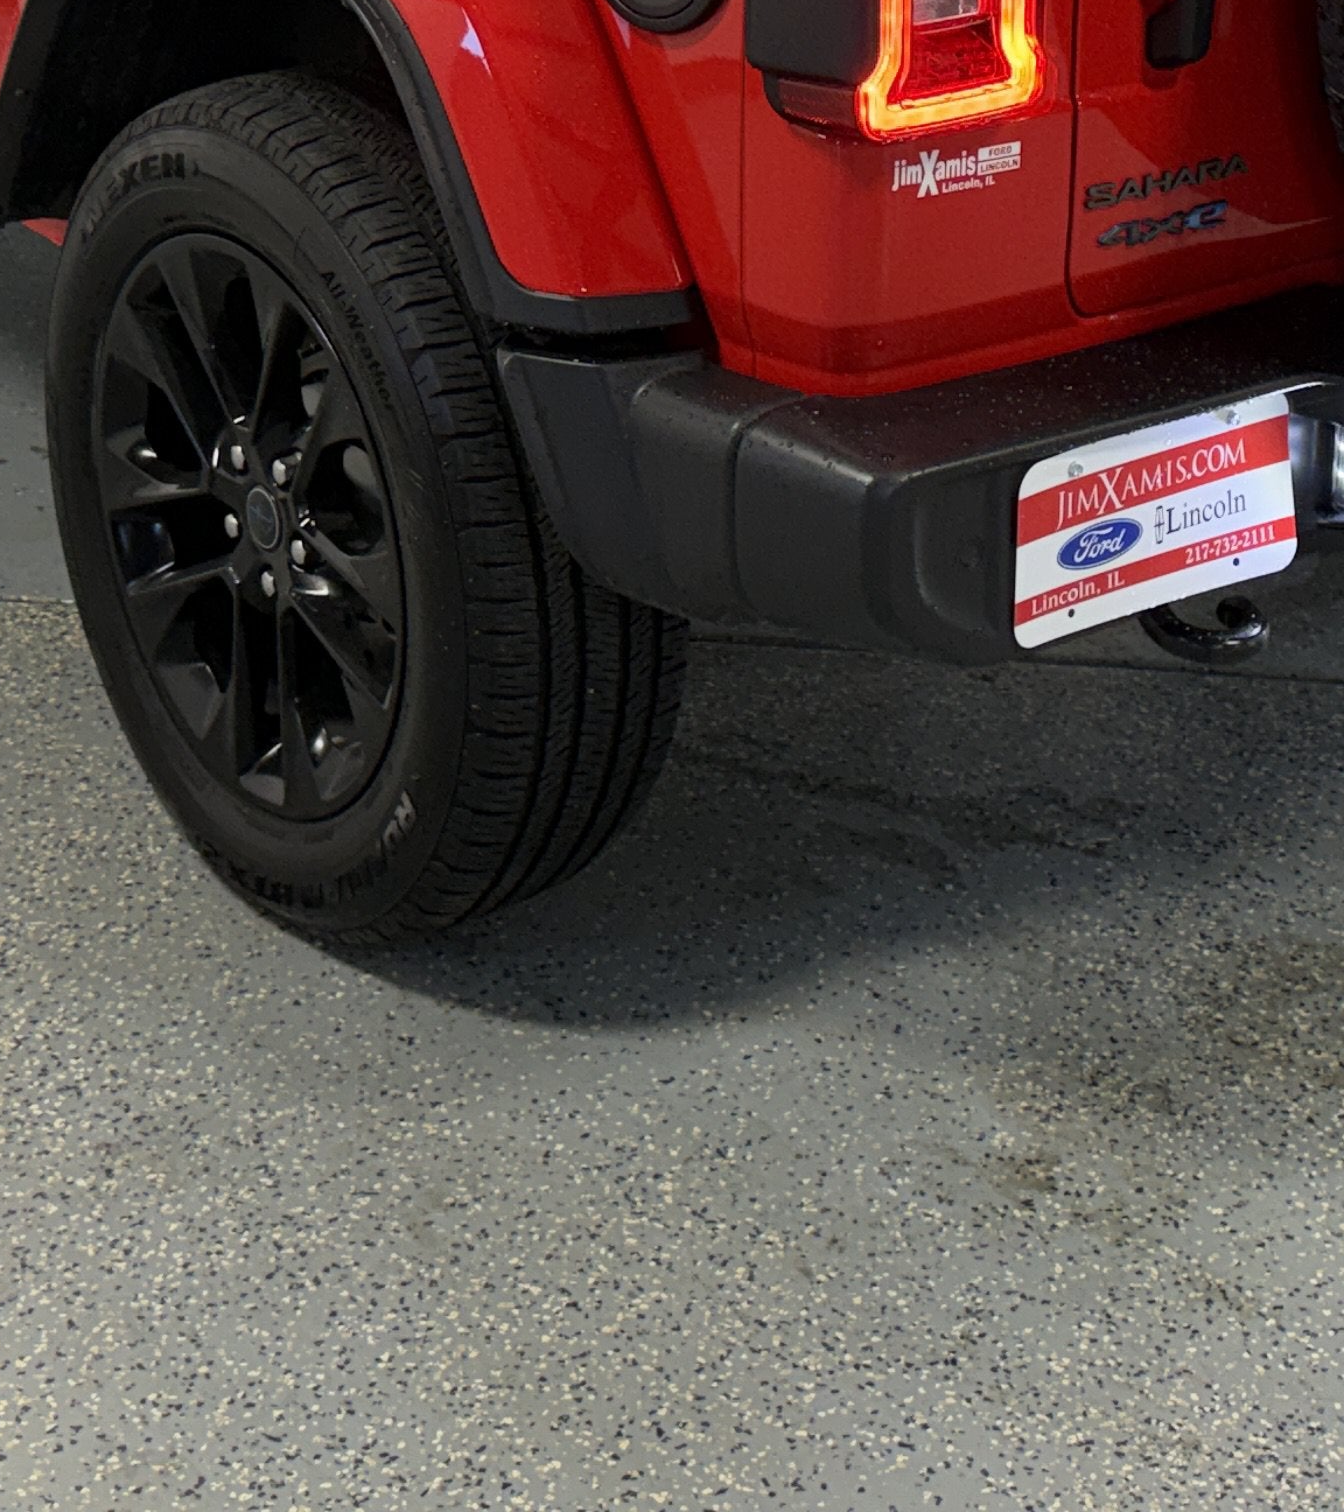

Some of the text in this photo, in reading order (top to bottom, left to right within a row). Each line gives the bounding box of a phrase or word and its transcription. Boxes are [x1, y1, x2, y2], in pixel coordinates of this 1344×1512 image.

[942, 175, 996, 194] Lincoln, IL
[1083, 153, 1249, 210] SAHARA
[1165, 489, 1247, 536] Lincoln
[1073, 526, 1125, 565] Ford
[1183, 524, 1276, 566] 217-732-2111
[1030, 572, 1126, 616] Lincoln, IL
